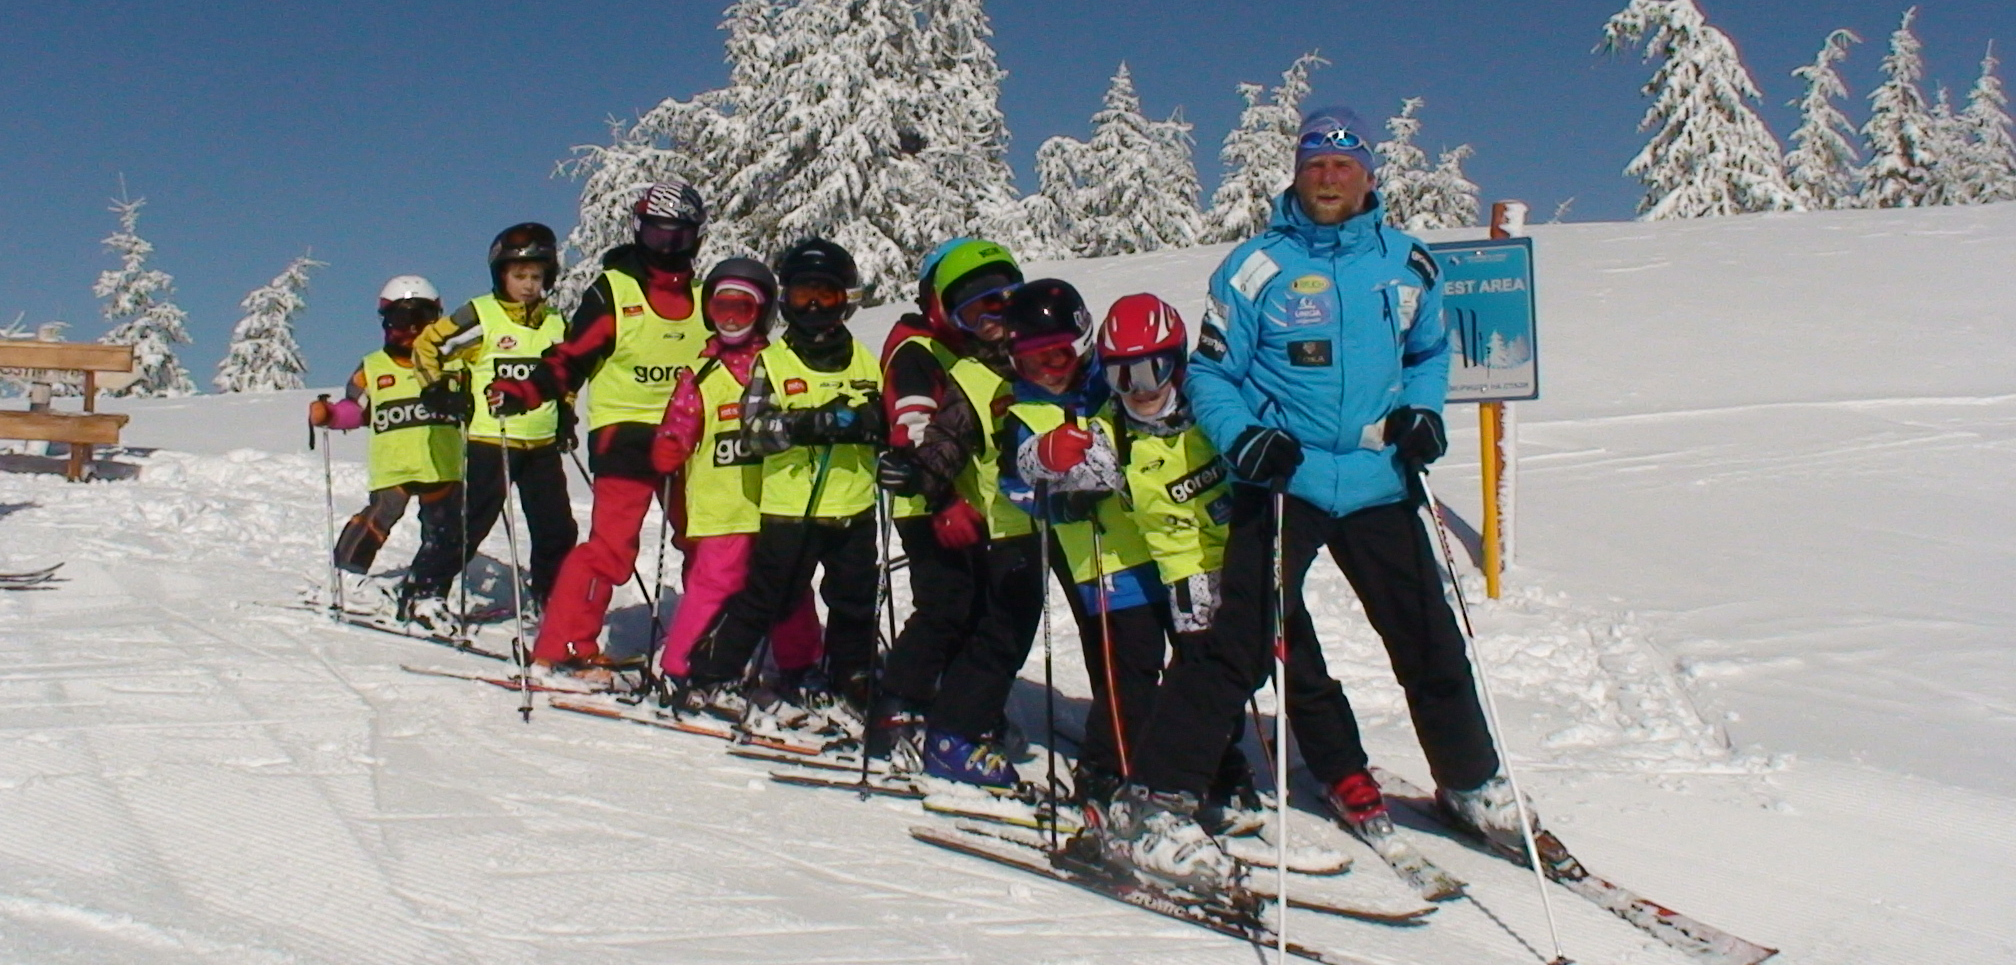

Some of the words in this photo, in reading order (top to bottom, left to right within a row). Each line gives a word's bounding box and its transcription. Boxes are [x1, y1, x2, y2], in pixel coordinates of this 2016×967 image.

[1443, 280, 1475, 295] EST
[1479, 277, 1526, 293] AREA
[374, 403, 459, 431] gore
